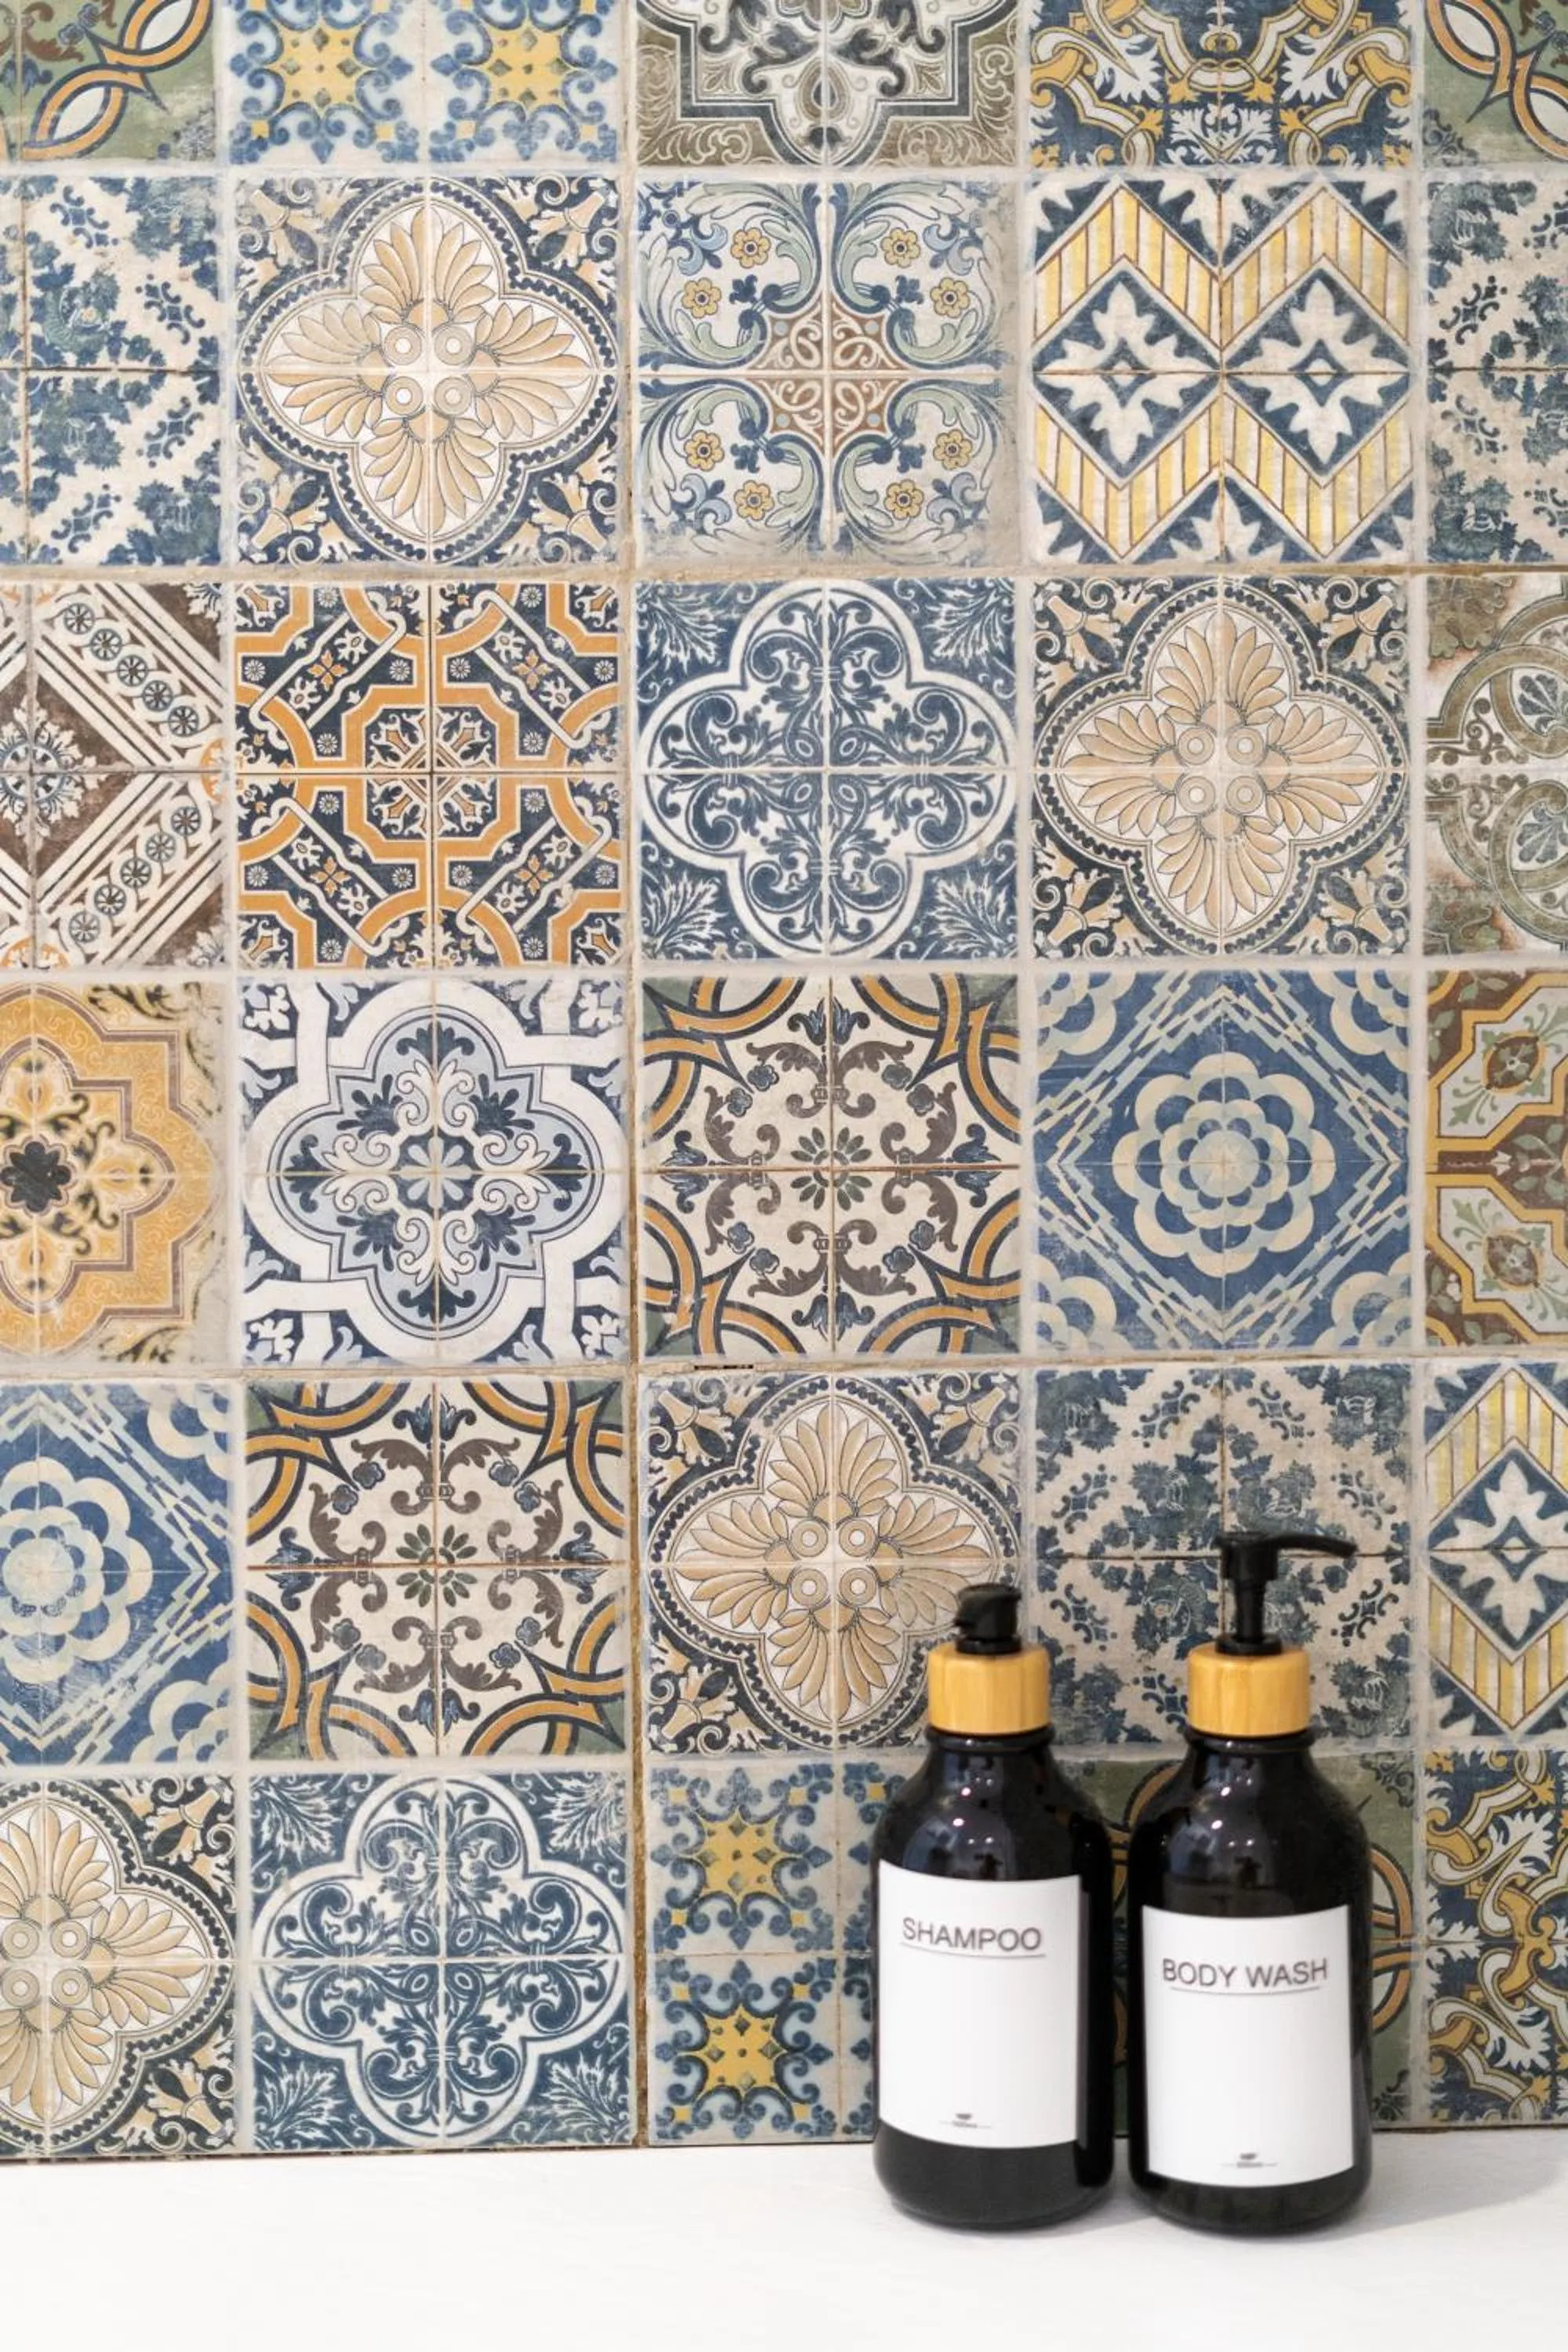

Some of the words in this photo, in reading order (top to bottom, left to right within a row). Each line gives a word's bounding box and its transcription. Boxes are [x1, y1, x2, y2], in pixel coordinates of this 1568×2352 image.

[902, 1917, 1041, 1951] SHAMPOO
[1162, 1958, 1237, 1987] BODY
[1246, 1958, 1328, 1987] WASH
